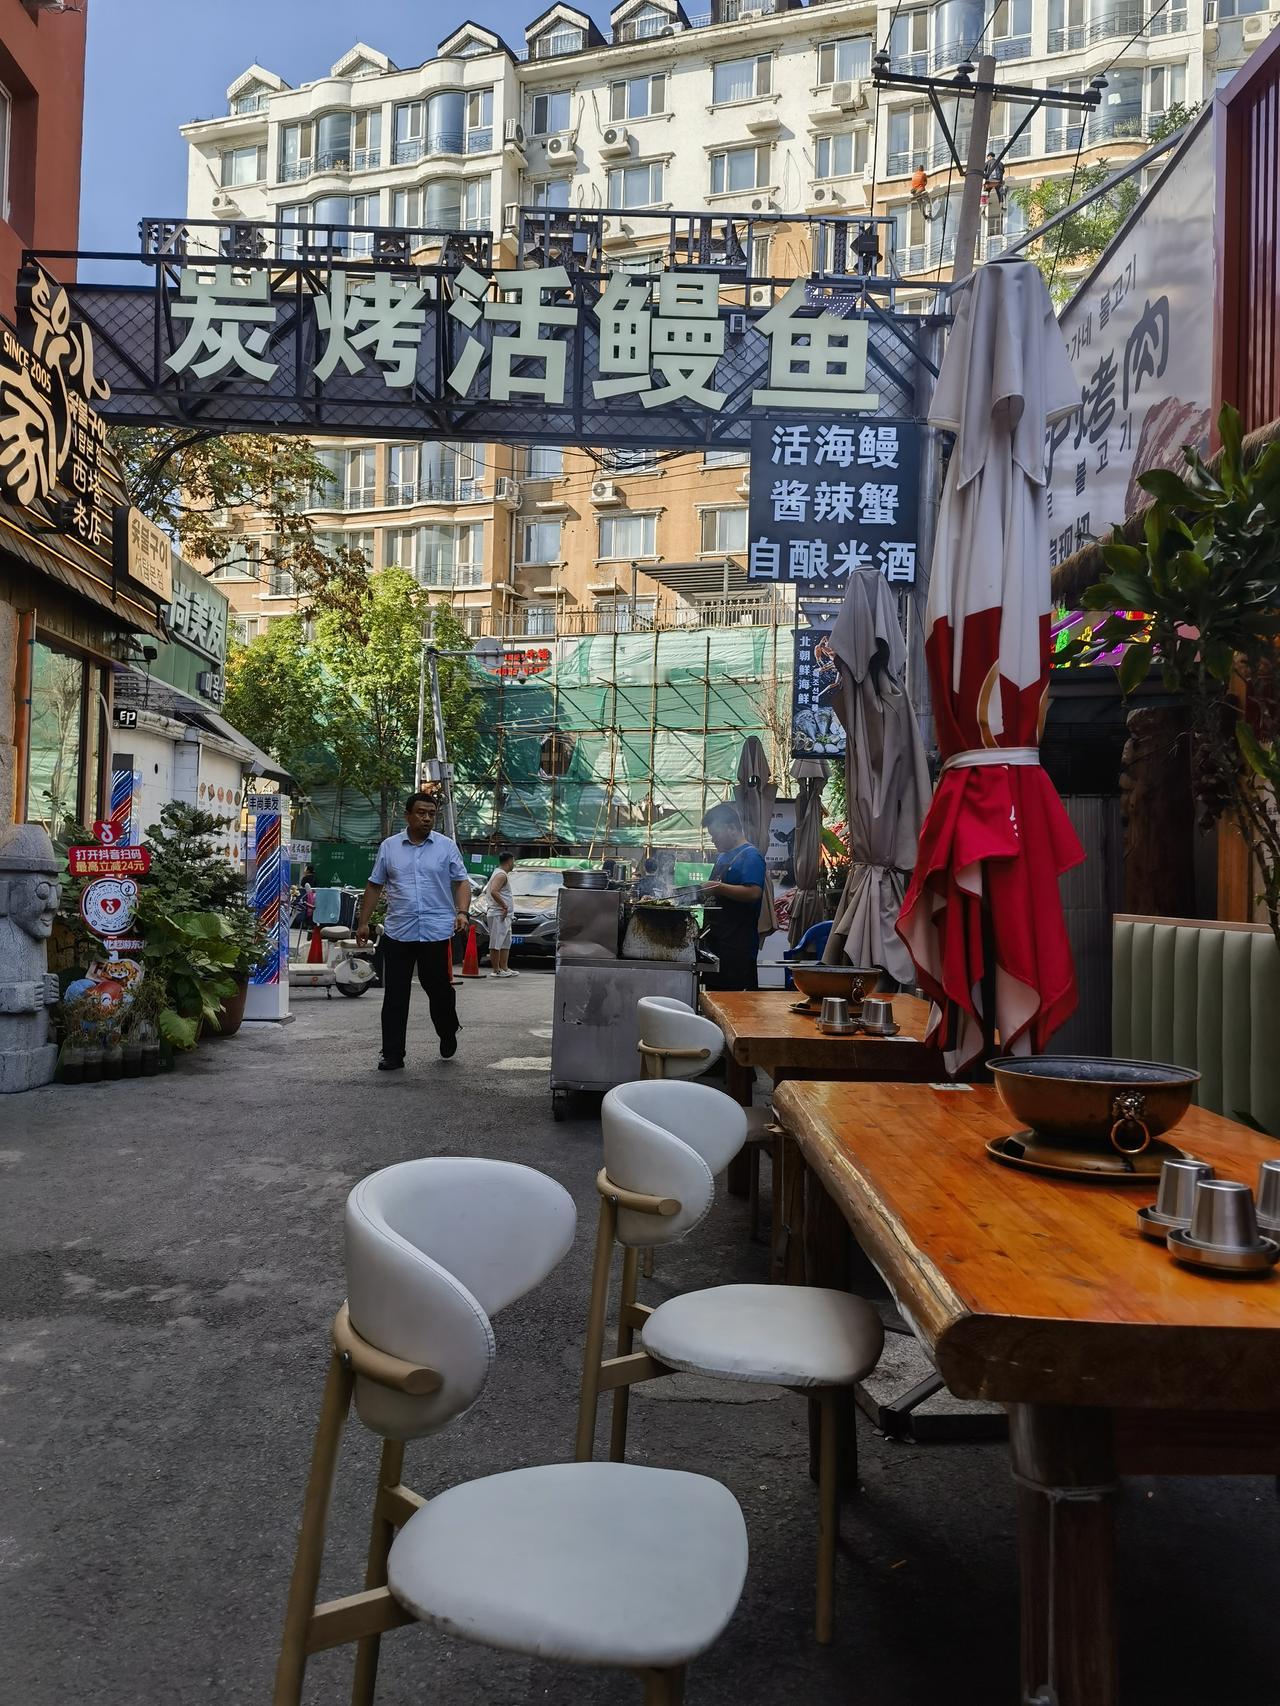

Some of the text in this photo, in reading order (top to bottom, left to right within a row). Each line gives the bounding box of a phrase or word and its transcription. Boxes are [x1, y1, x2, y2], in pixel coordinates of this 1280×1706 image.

[1099, 253, 1137, 331] 불고기
[165, 264, 880, 411] 炭烤活鳗鱼
[3, 331, 52, 393] SINCE 2005
[68, 390, 107, 448] 숯불구이
[771, 424, 899, 469] 活海鳗
[72, 453, 103, 504] 西塔
[72, 500, 102, 547] 老店
[770, 479, 899, 526] 酱辣蟹
[131, 518, 169, 570] 숯불구이
[749, 536, 917, 583] 自酿米酒
[135, 555, 165, 591] 서탑본점
[798, 636, 811, 705] 北朝鲜海鲜
[249, 796, 279, 811] 丰尚美发
[75, 849, 142, 860] 打开抖音扫码
[76, 860, 145, 873] 最高立减24元
